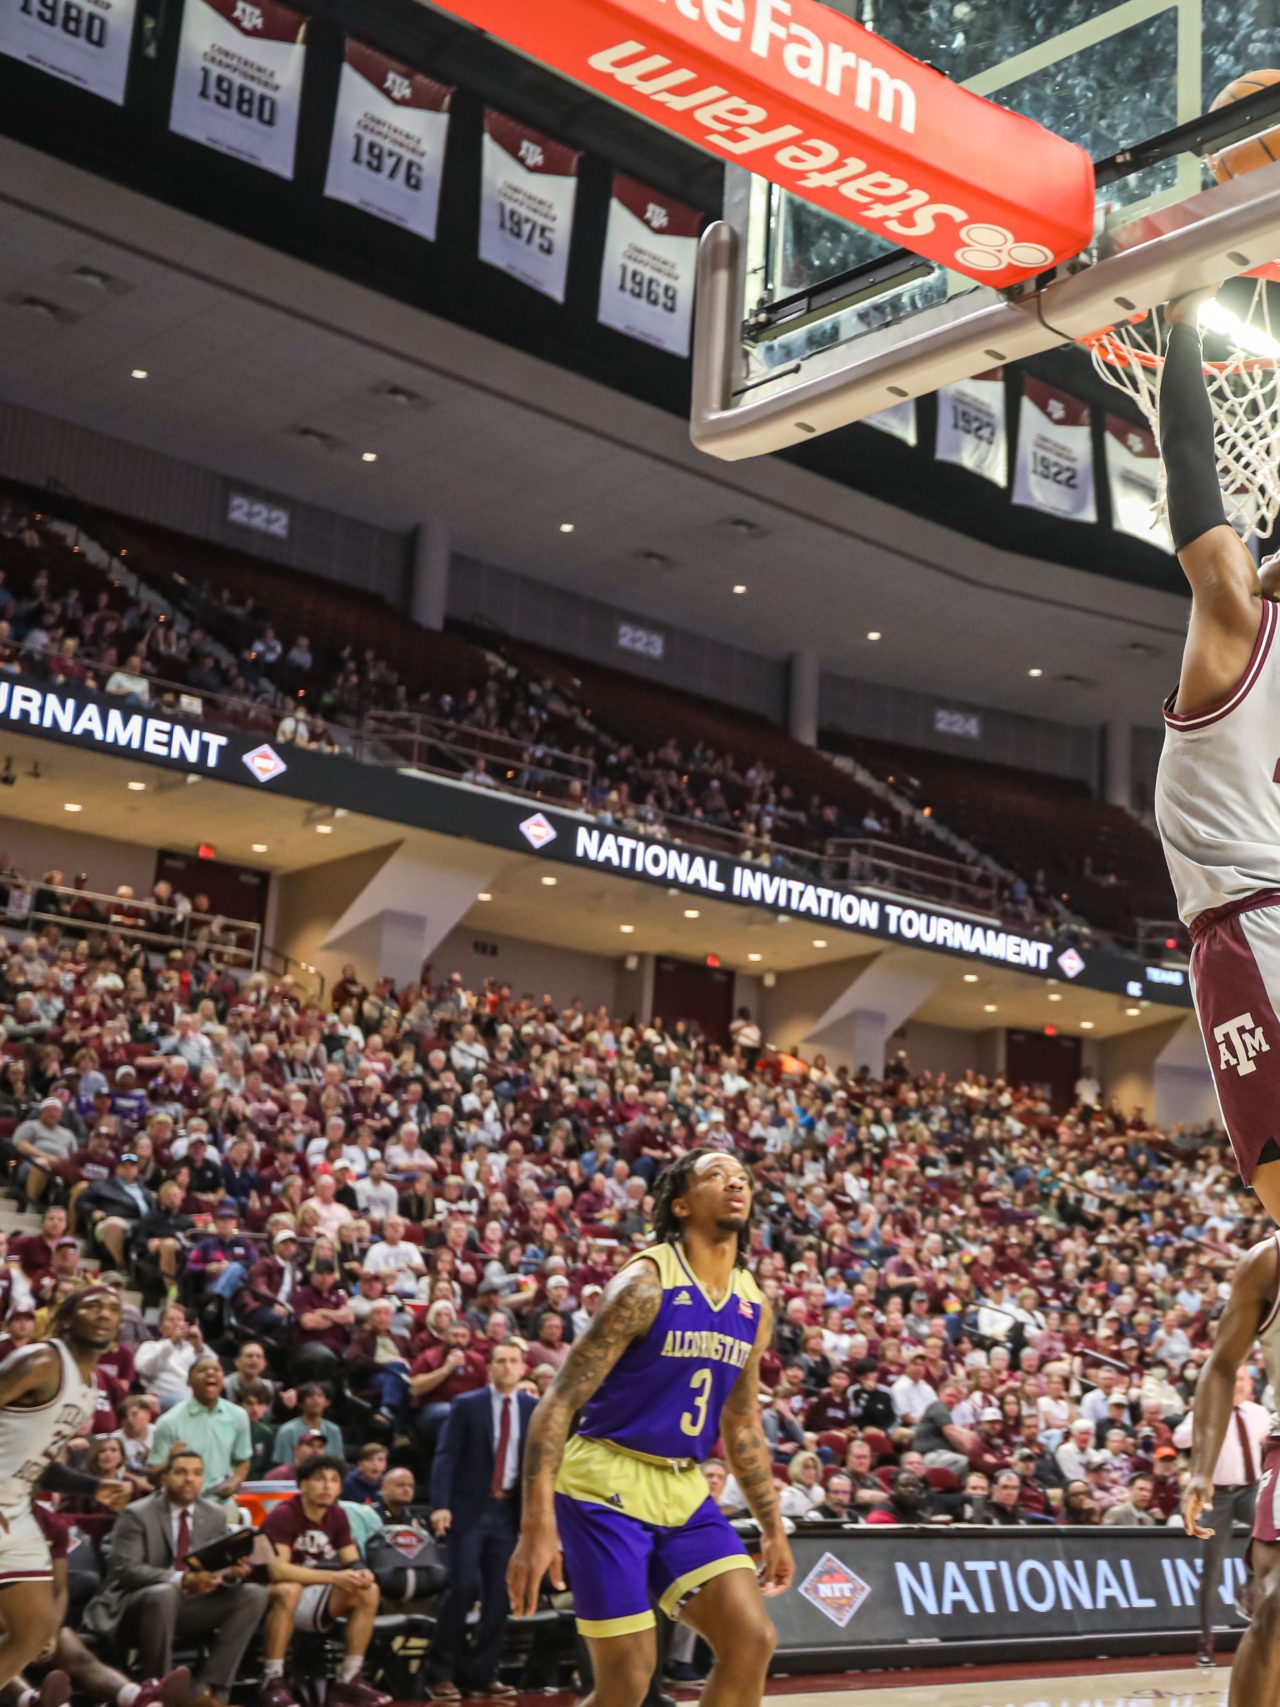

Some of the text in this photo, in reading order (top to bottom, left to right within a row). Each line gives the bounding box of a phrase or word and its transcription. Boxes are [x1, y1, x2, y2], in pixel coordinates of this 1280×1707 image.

[198, 65, 278, 127] 1980
[351, 132, 423, 192] 1976
[587, 39, 967, 237] StateFarm
[497, 201, 556, 256] 1975
[619, 263, 678, 314] 1969
[1032, 452, 1079, 490] 1922
[229, 495, 289, 537] 222
[618, 623, 665, 660] 223
[934, 708, 981, 738] 224
[576, 826, 1053, 970] NATIONAL INVITATION TOURNAMENT
[679, 1368, 713, 1437] 3
[817, 1583, 852, 1598] NIT
[894, 1558, 1157, 1616] NATIONAL
